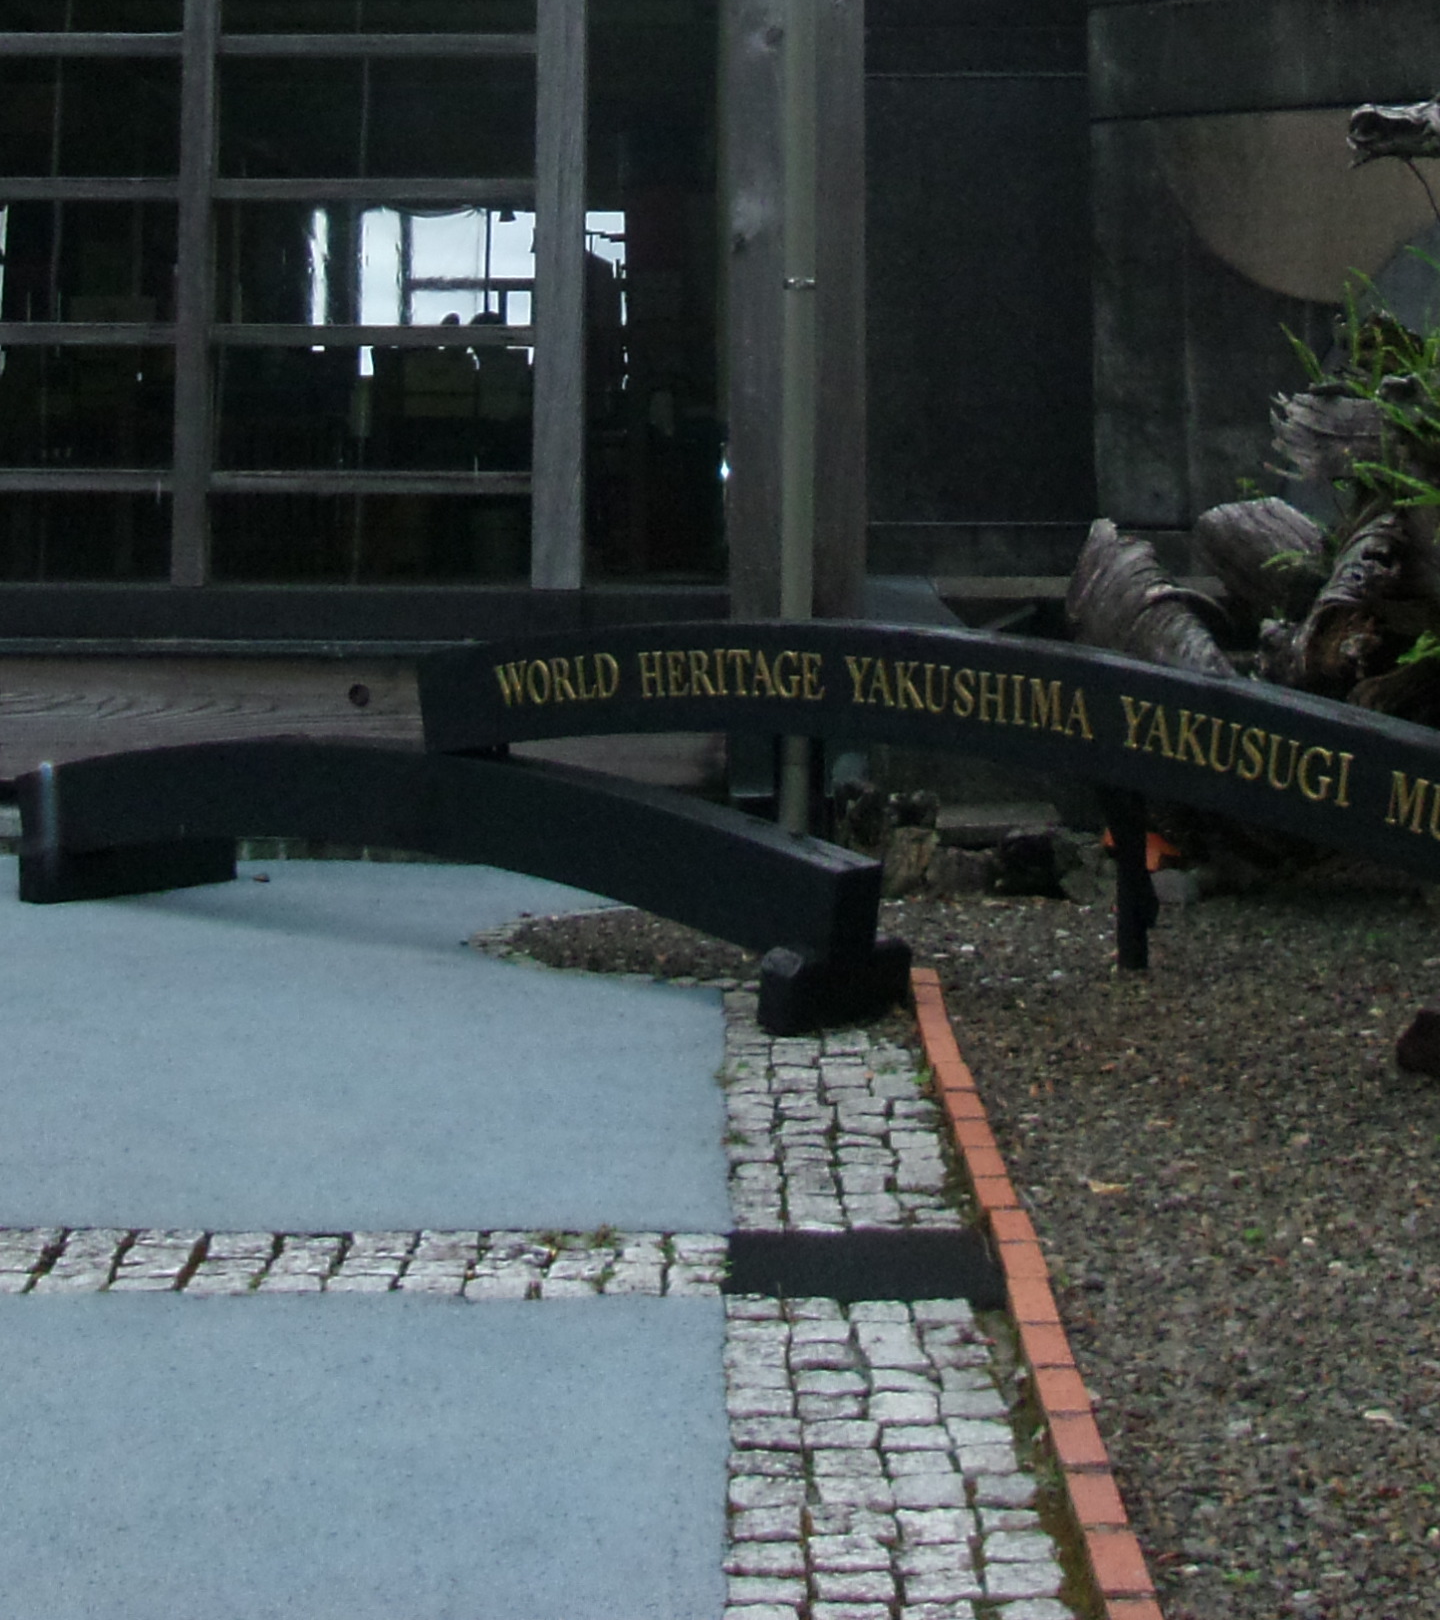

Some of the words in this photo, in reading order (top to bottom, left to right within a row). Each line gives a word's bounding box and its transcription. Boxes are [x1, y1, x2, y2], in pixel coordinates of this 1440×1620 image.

[495, 651, 620, 707] WORLD
[638, 648, 825, 701] HERITAGE
[844, 654, 1095, 741] YAKUSHIMA
[1120, 695, 1355, 808] YAKUSUGI
